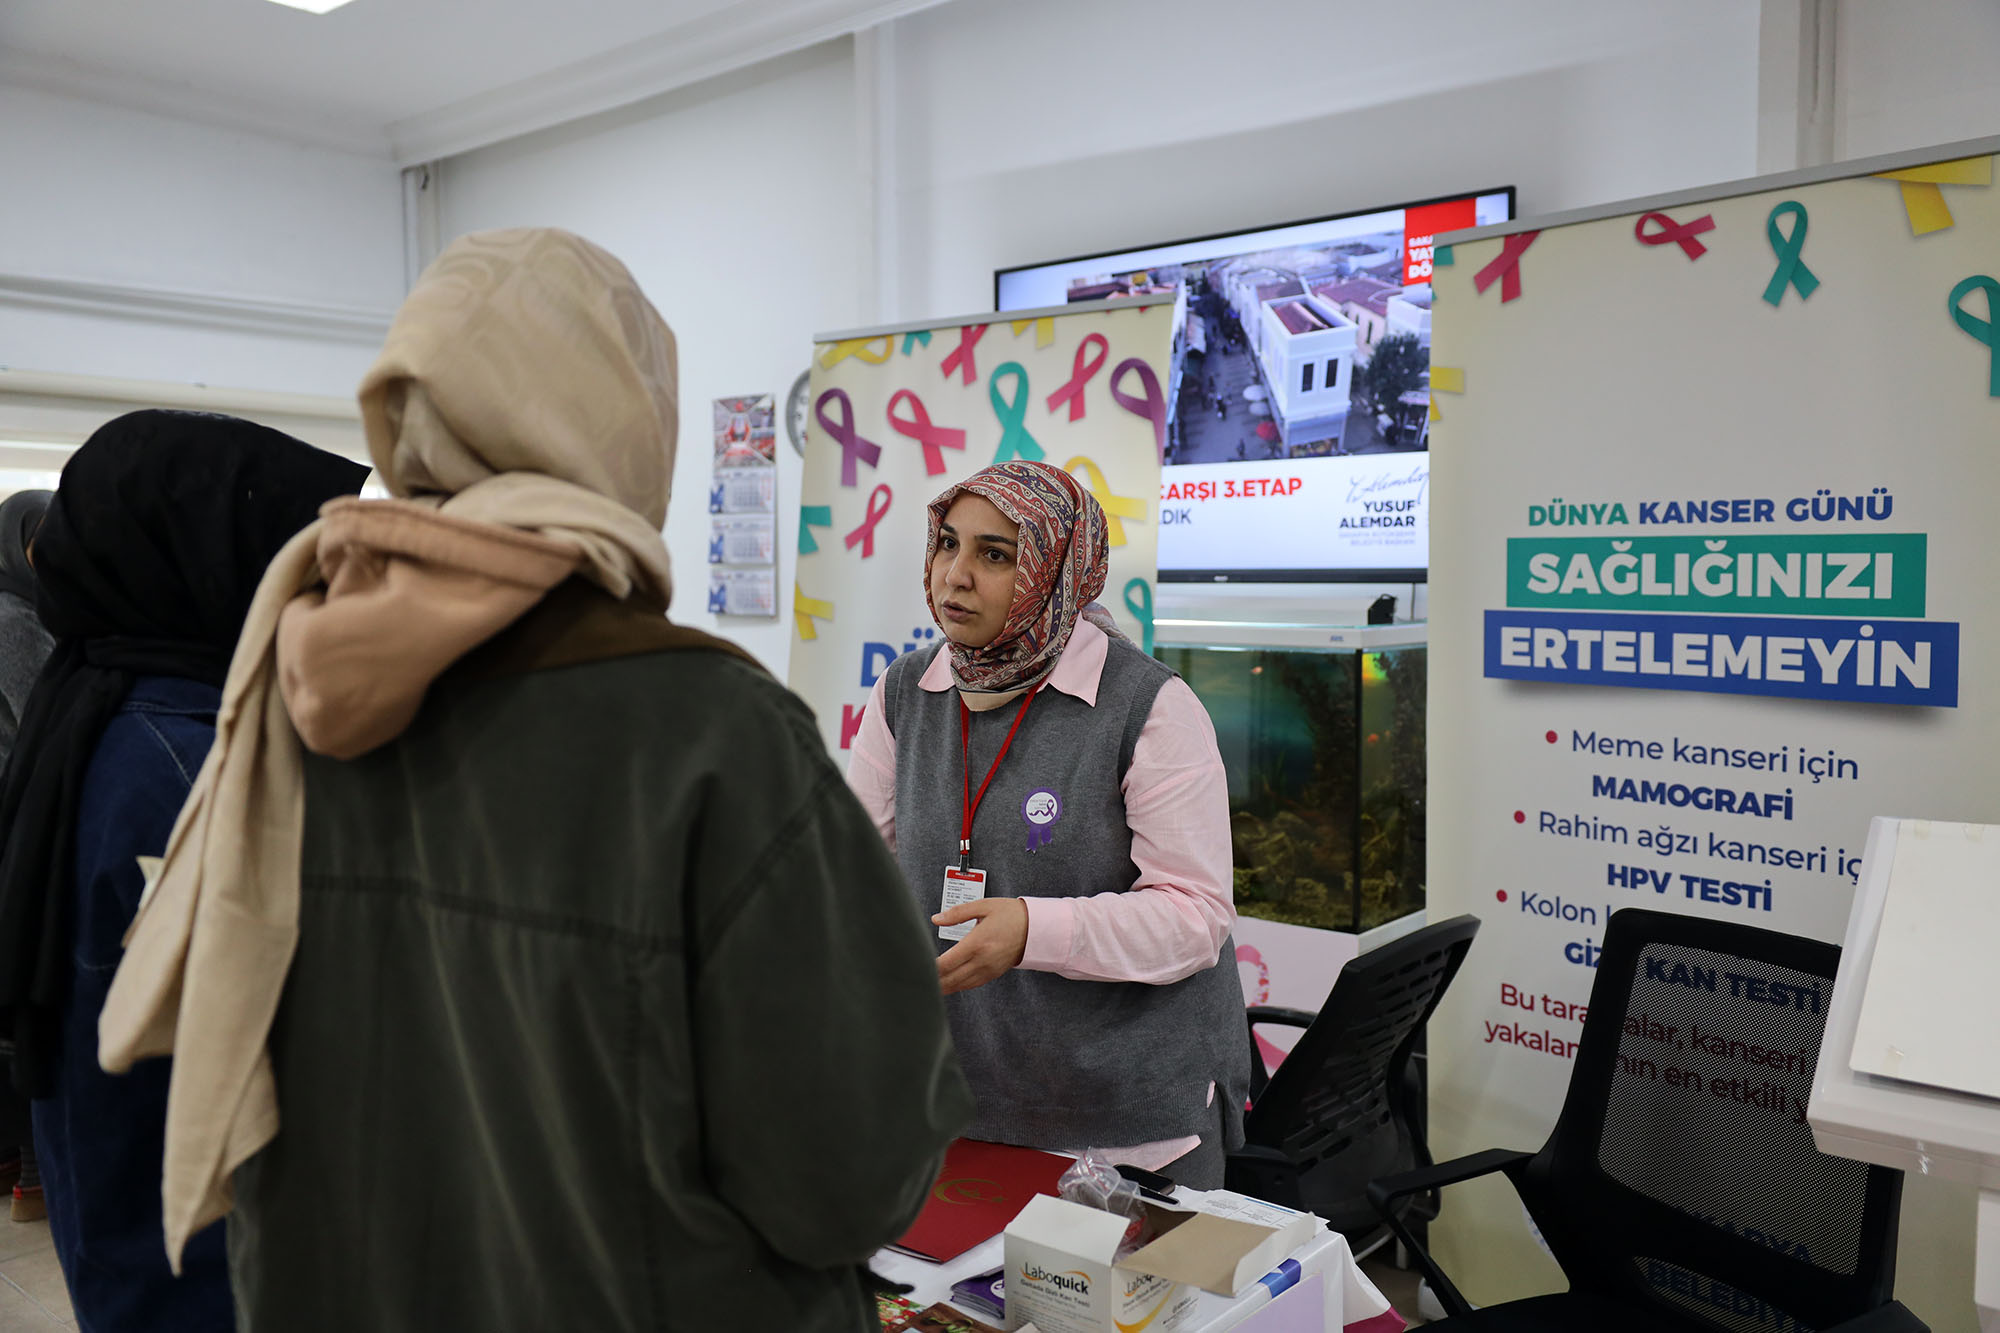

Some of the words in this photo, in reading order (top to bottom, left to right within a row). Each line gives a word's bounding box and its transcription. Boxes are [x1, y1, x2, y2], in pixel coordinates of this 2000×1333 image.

[1160, 481, 1216, 502] ARŞI
[1224, 477, 1302, 498] 3.ETAP
[1364, 500, 1415, 512] YUSUF
[1528, 498, 1629, 526] DÜNYA
[1639, 499, 1775, 525] KANSER
[1786, 487, 1893, 522] GÜNÜ
[1159, 508, 1192, 525] DIK
[1340, 516, 1415, 528] ALEMDAR
[1527, 540, 1893, 599] SAĞLIĞINIZI
[1500, 624, 1931, 689] ERTELEMEYİN
[1572, 730, 1663, 760] Meme
[1673, 737, 1788, 773] kanseri
[1799, 748, 1858, 783] için
[1592, 775, 1793, 820] MAMOGRAFİ
[1539, 811, 1628, 844] Rahim
[1637, 825, 1697, 856] ağzı
[1709, 833, 1827, 873] kanseri
[1838, 848, 1862, 886] iç
[1521, 891, 1596, 926] Kolon
[1607, 863, 1671, 894] HPV
[1680, 874, 1772, 912] TESTİ
[1564, 938, 1603, 969] GİZ
[1645, 958, 1716, 993] KAN
[1725, 972, 1822, 1015] TESTİ
[1500, 983, 1535, 1012] Bu
[1691, 1025, 1807, 1075] kanseri
[1665, 1065, 1702, 1092] en
[1710, 1077, 1786, 1114] etkili
[1025, 1262, 1089, 1295] Laboquick
